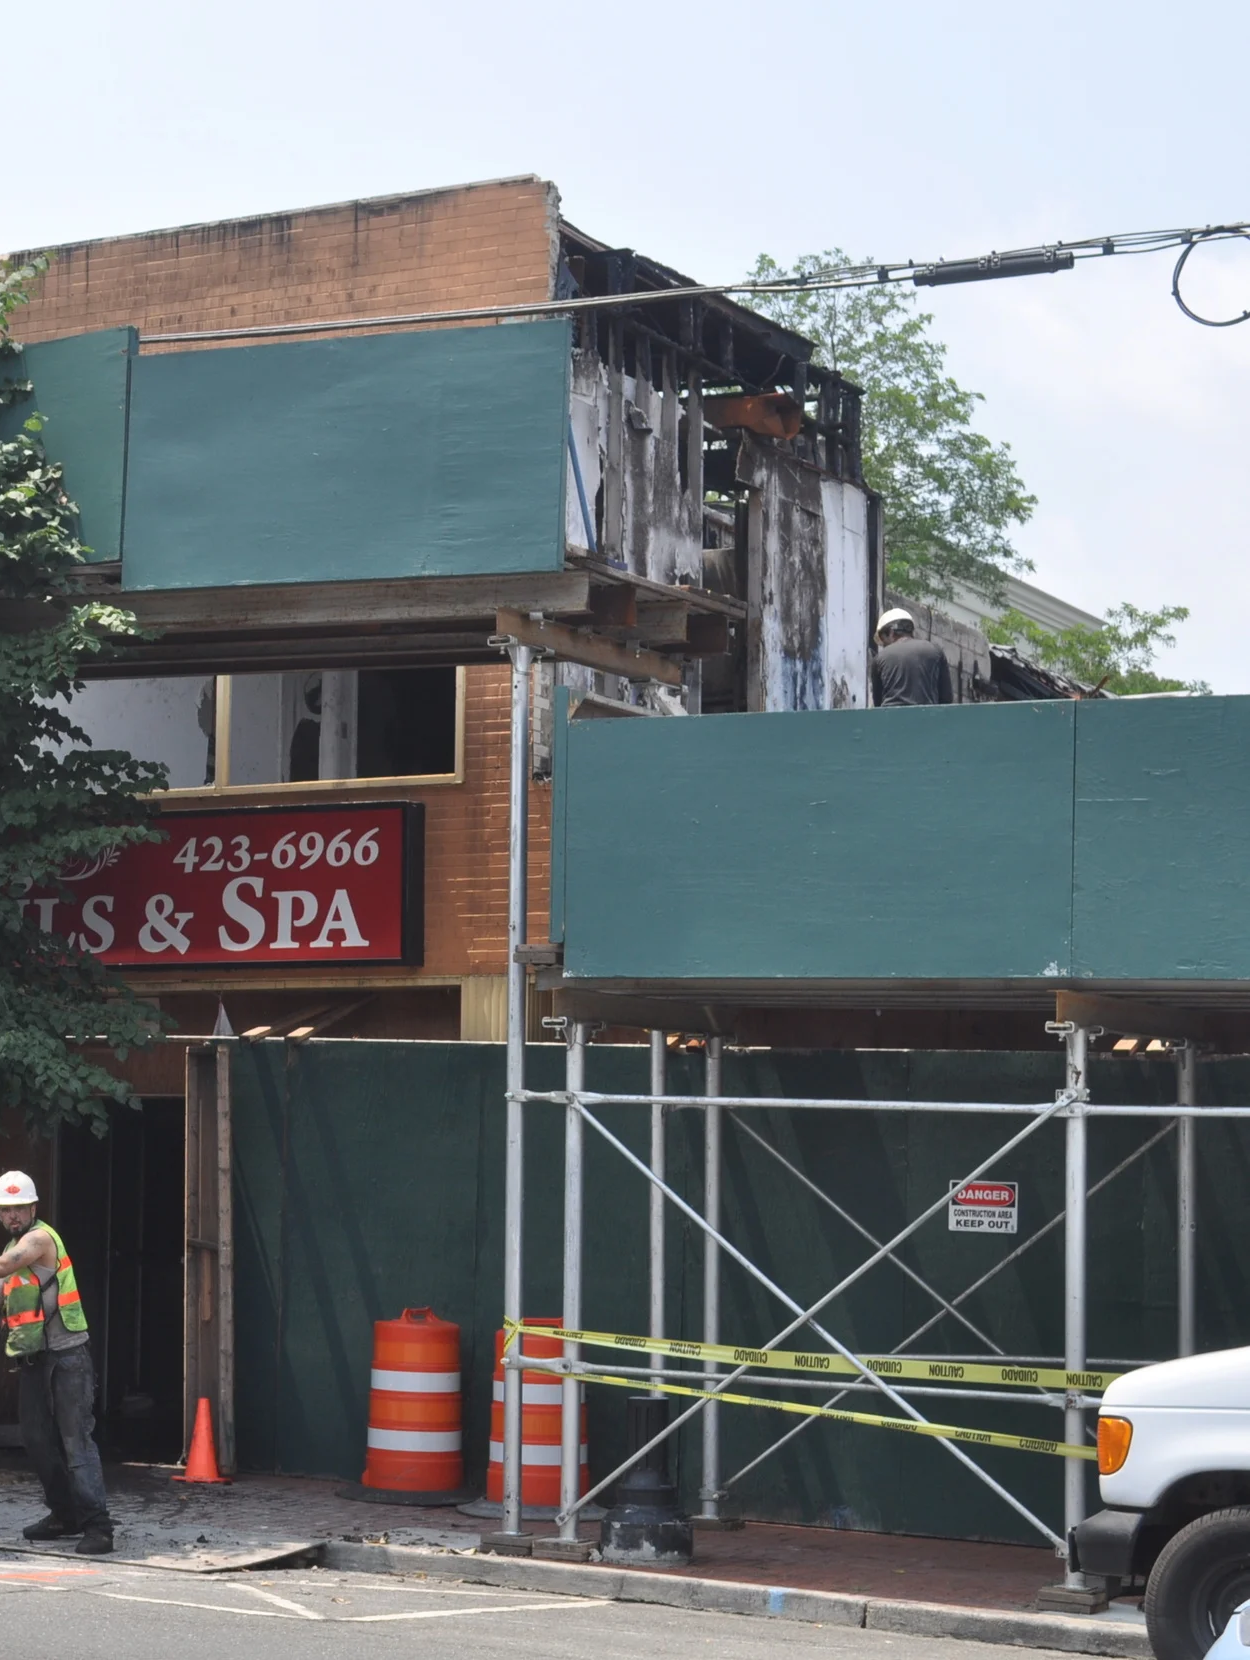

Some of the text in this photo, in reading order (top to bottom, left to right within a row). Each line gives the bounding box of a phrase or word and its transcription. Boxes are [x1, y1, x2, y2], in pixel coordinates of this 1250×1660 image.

[173, 827, 379, 873] 423-6966
[16, 895, 115, 954] LS
[138, 894, 194, 955] &
[957, 1190, 1009, 1201] DANGER
[953, 1209, 1013, 1219] CONSTRUCTION AREA
[955, 1219, 984, 1228] KEEP
[988, 1221, 1011, 1229] OUT
[614, 1336, 646, 1348] CUIDADO
[669, 1342, 701, 1356] CAUTION
[734, 1349, 767, 1364] CUIDADO
[795, 1355, 830, 1369] CAUTION
[867, 1360, 902, 1374] CUIDADO
[929, 1364, 964, 1379] CAUTION
[1002, 1368, 1038, 1383] CUIDADO
[1066, 1373, 1103, 1388] CAUTION
